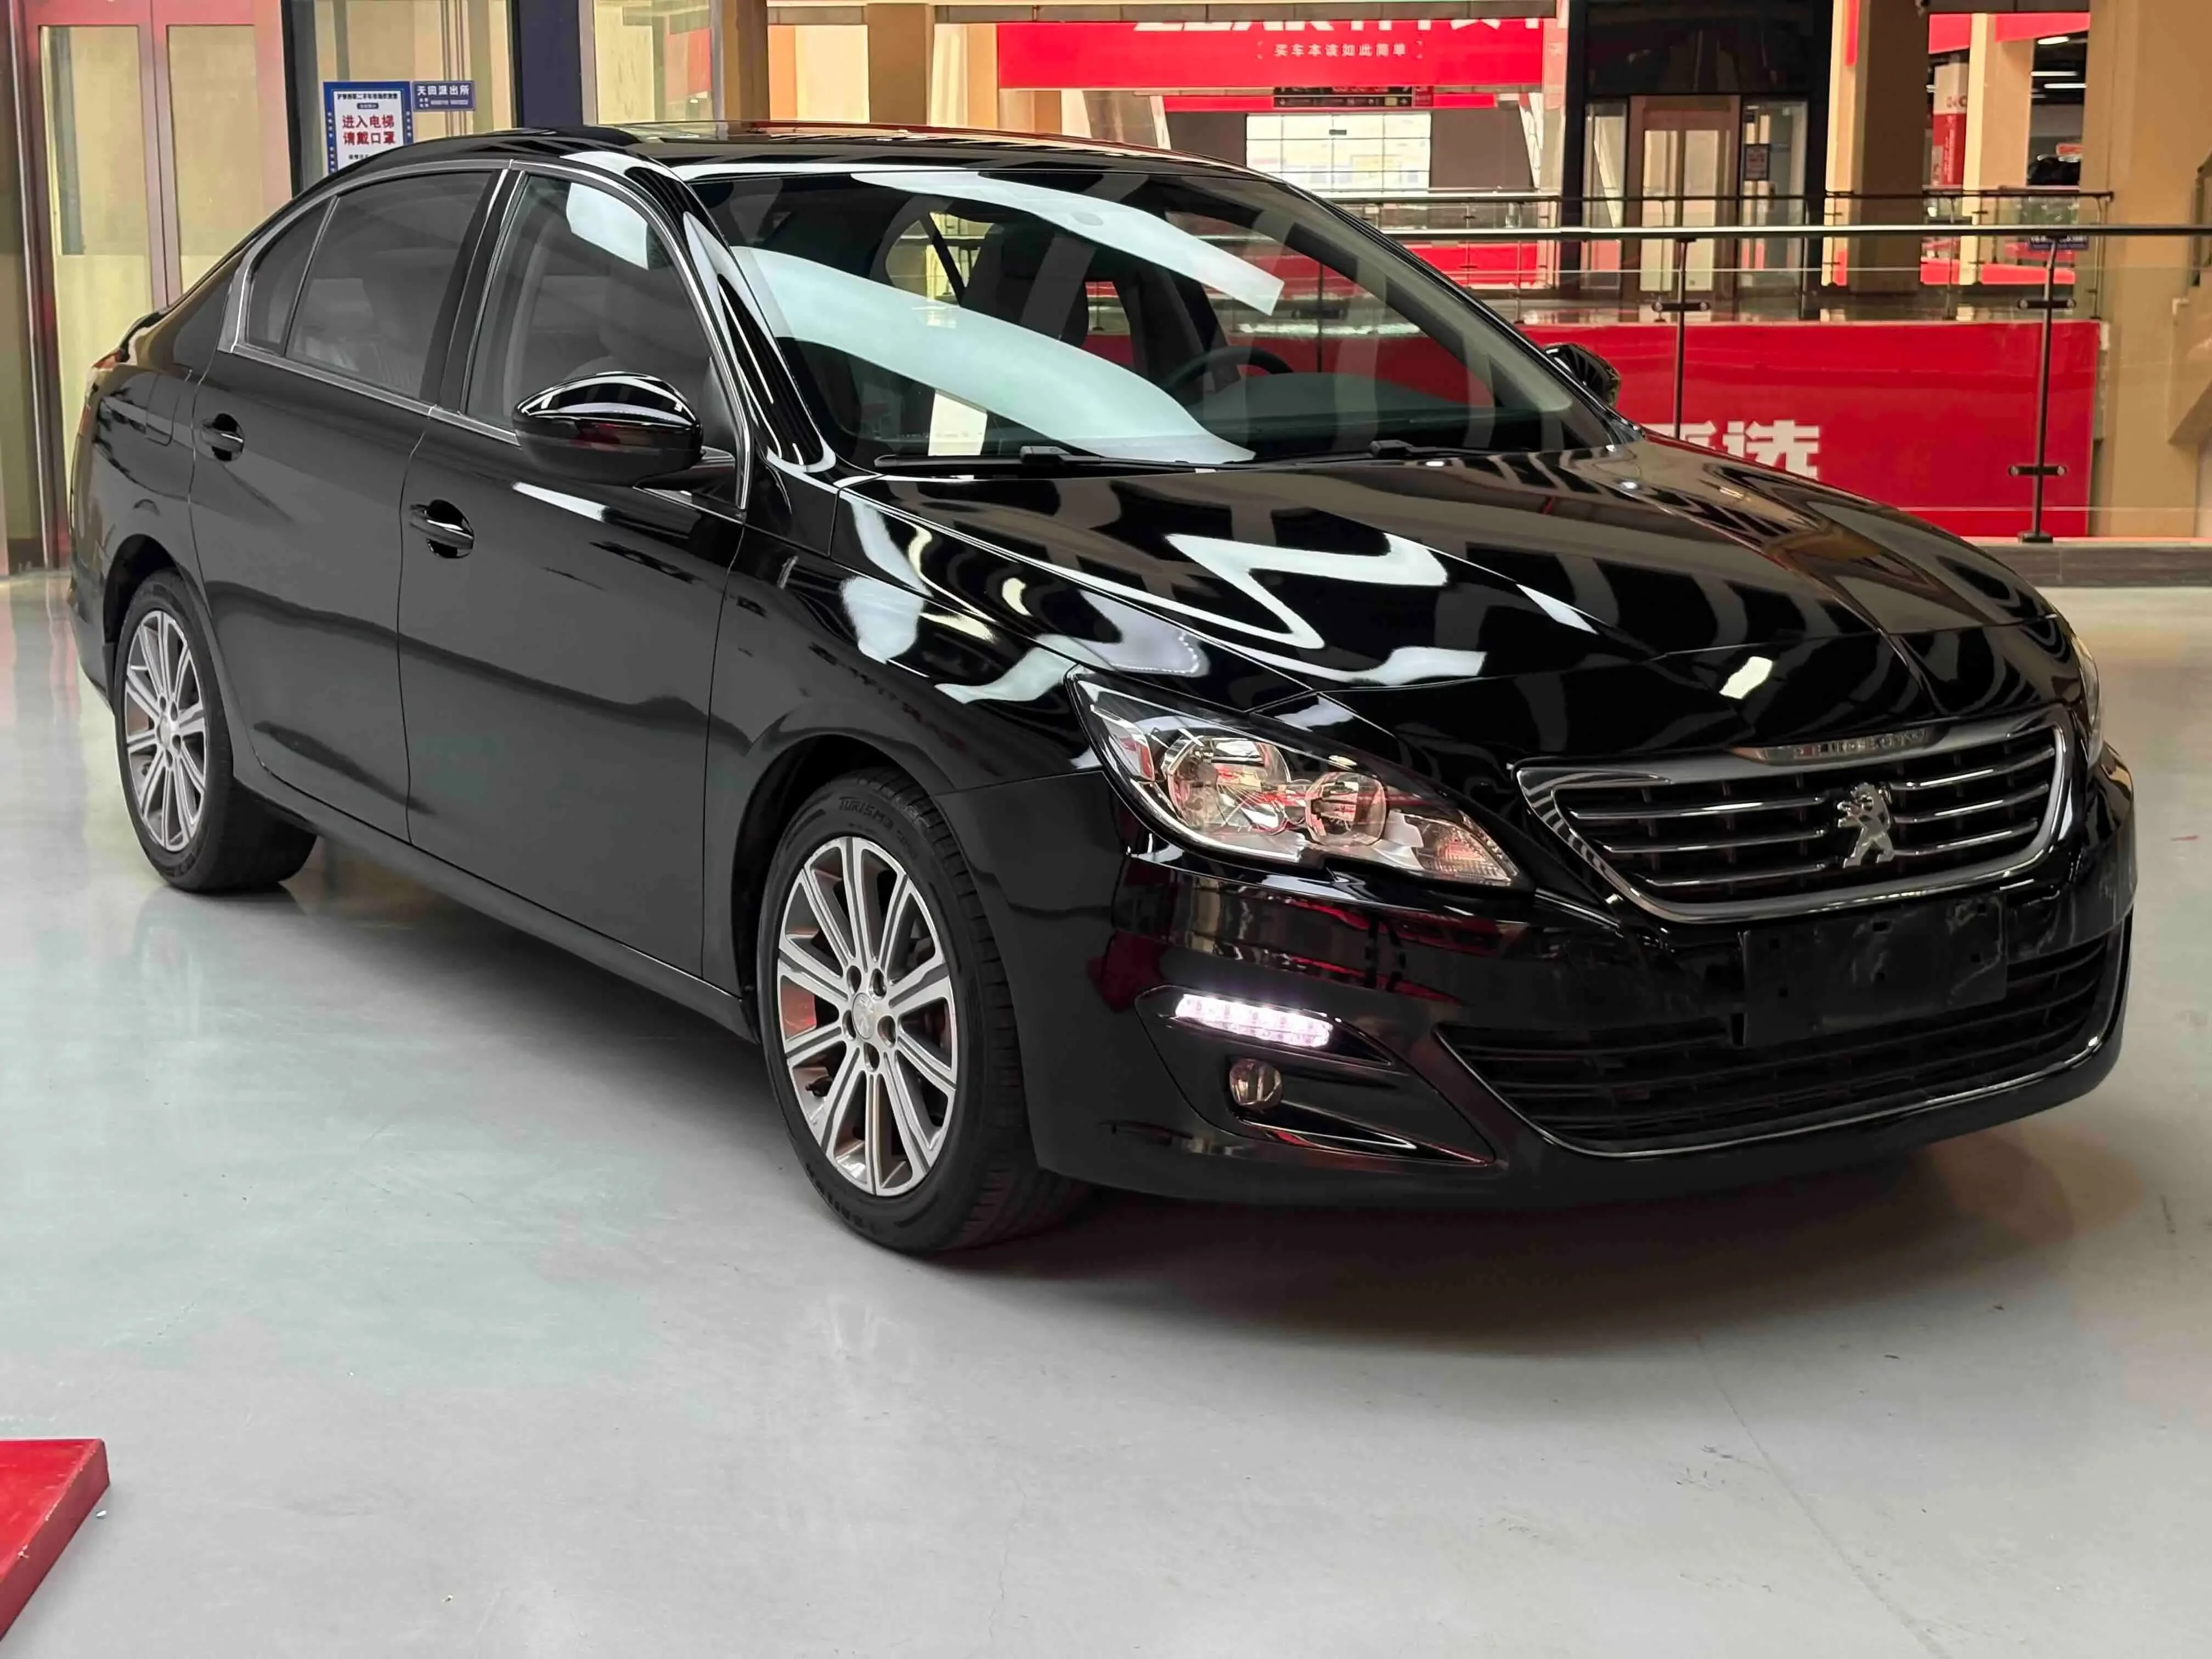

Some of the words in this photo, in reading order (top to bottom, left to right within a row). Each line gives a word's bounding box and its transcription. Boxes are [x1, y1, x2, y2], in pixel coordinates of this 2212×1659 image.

[1274, 43, 1407, 57] 买车本该如此简单
[342, 114, 395, 128] 进入电梯
[343, 131, 396, 145] 请戴口罩
